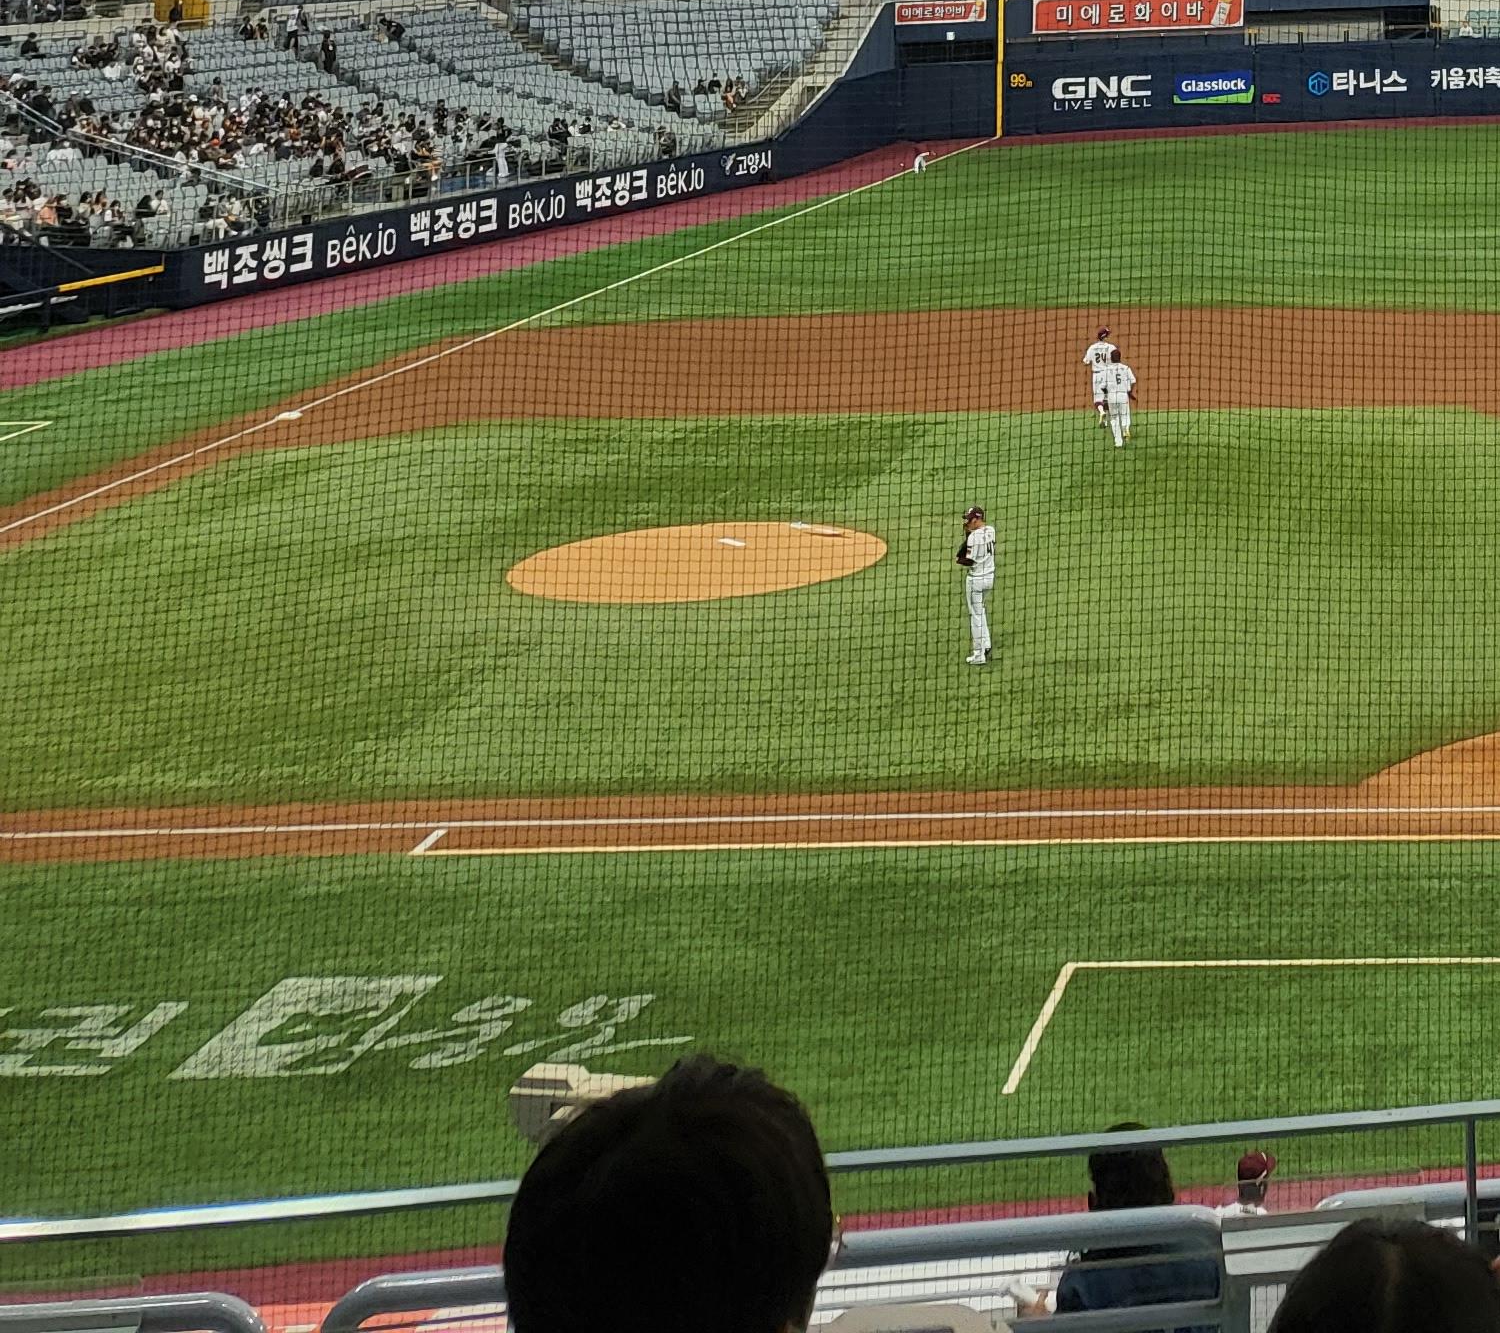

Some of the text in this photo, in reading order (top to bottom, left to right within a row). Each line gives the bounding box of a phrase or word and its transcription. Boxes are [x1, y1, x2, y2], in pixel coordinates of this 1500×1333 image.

[901, 6, 967, 20] 미에로화이바
[1056, 0, 1204, 26] 미에로화이바
[1010, 74, 1033, 88] 99m
[1052, 75, 1152, 100] GNC
[1181, 77, 1246, 93] Glasslock
[1332, 68, 1408, 96] 타니스
[1053, 98, 1152, 111] LIVE WELL
[735, 150, 772, 176] 고양시
[575, 168, 648, 212] 백조씽크
[410, 197, 498, 247] 백조씽크
[203, 232, 314, 290] 백조씽크
